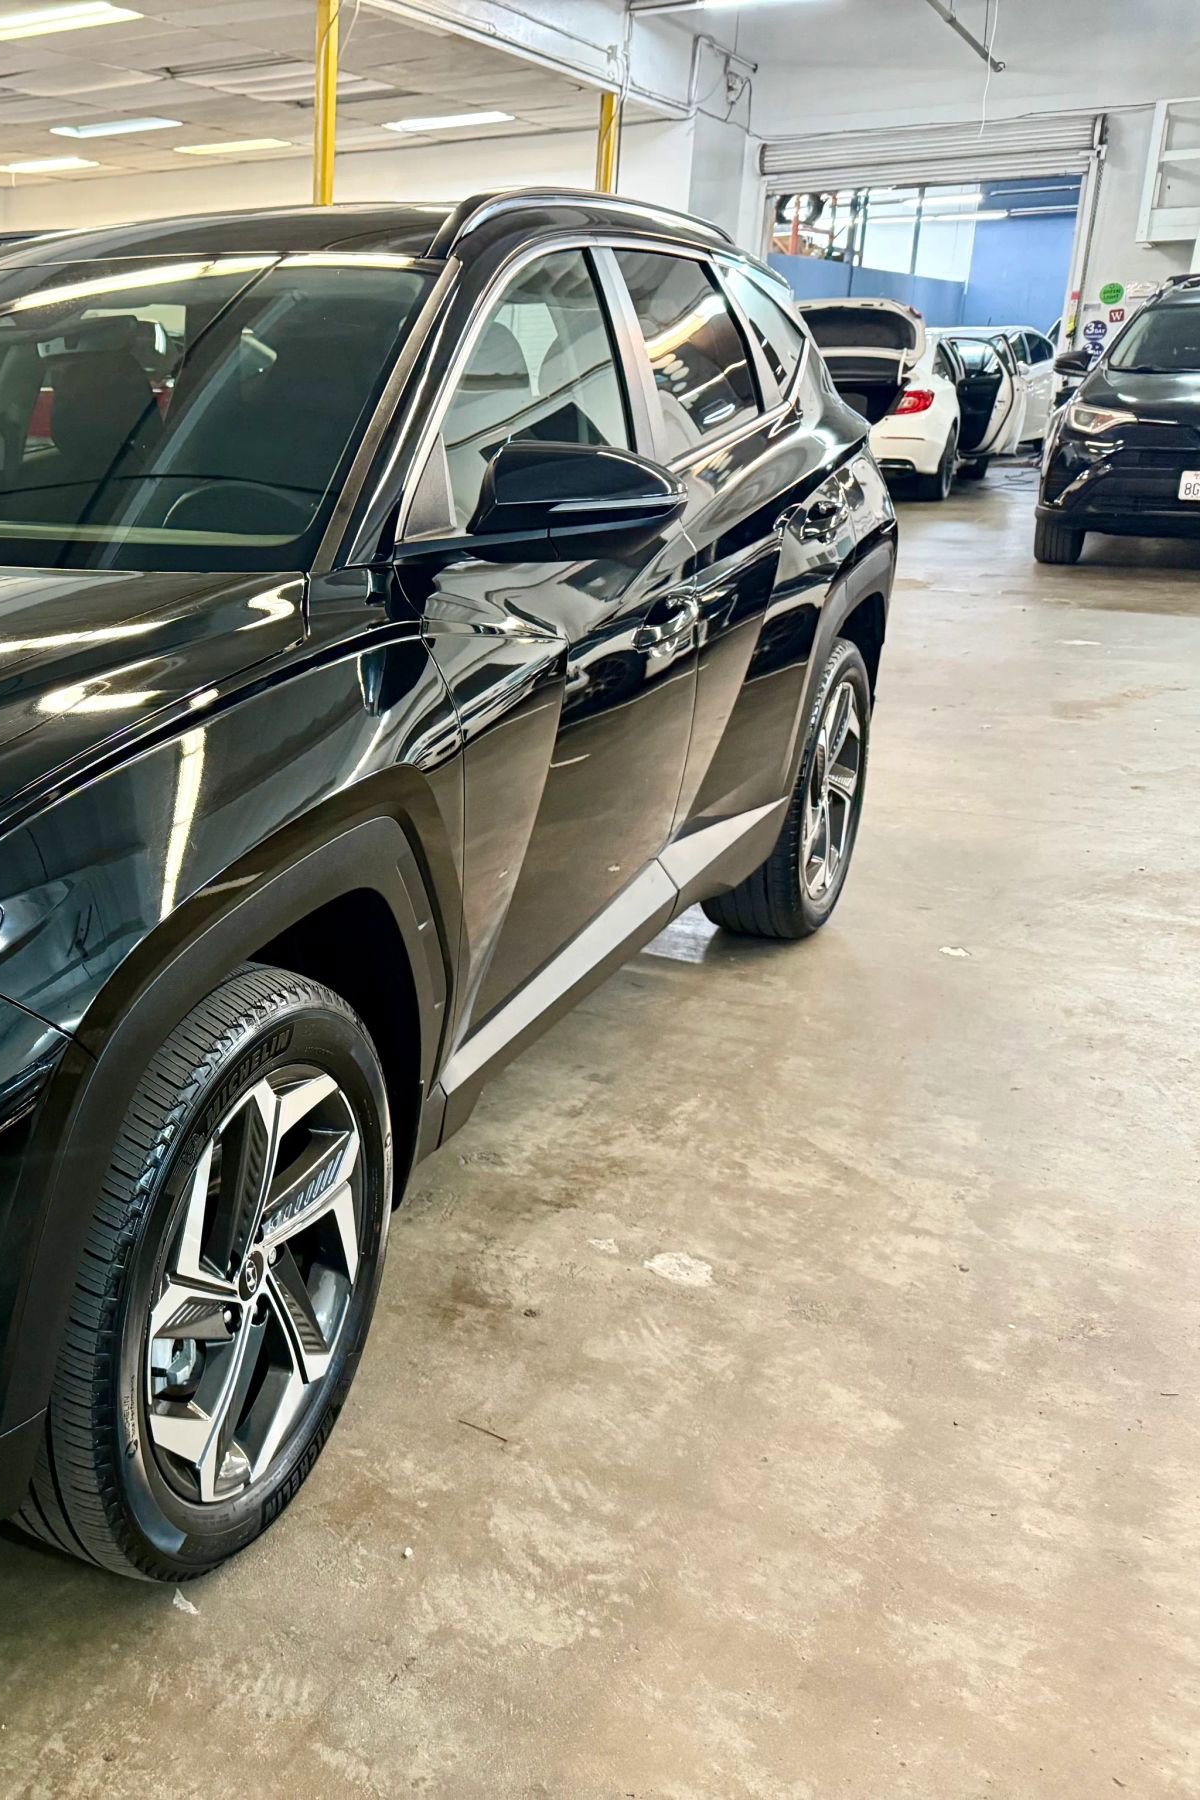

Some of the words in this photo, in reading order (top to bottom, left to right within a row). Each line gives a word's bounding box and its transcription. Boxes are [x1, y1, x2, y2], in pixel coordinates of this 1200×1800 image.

[1085, 323, 1095, 334] 3
[1110, 311, 1123, 322] W
[206, 1028, 291, 1130] MICHELIN
[265, 1410, 335, 1522] MICHELIN
